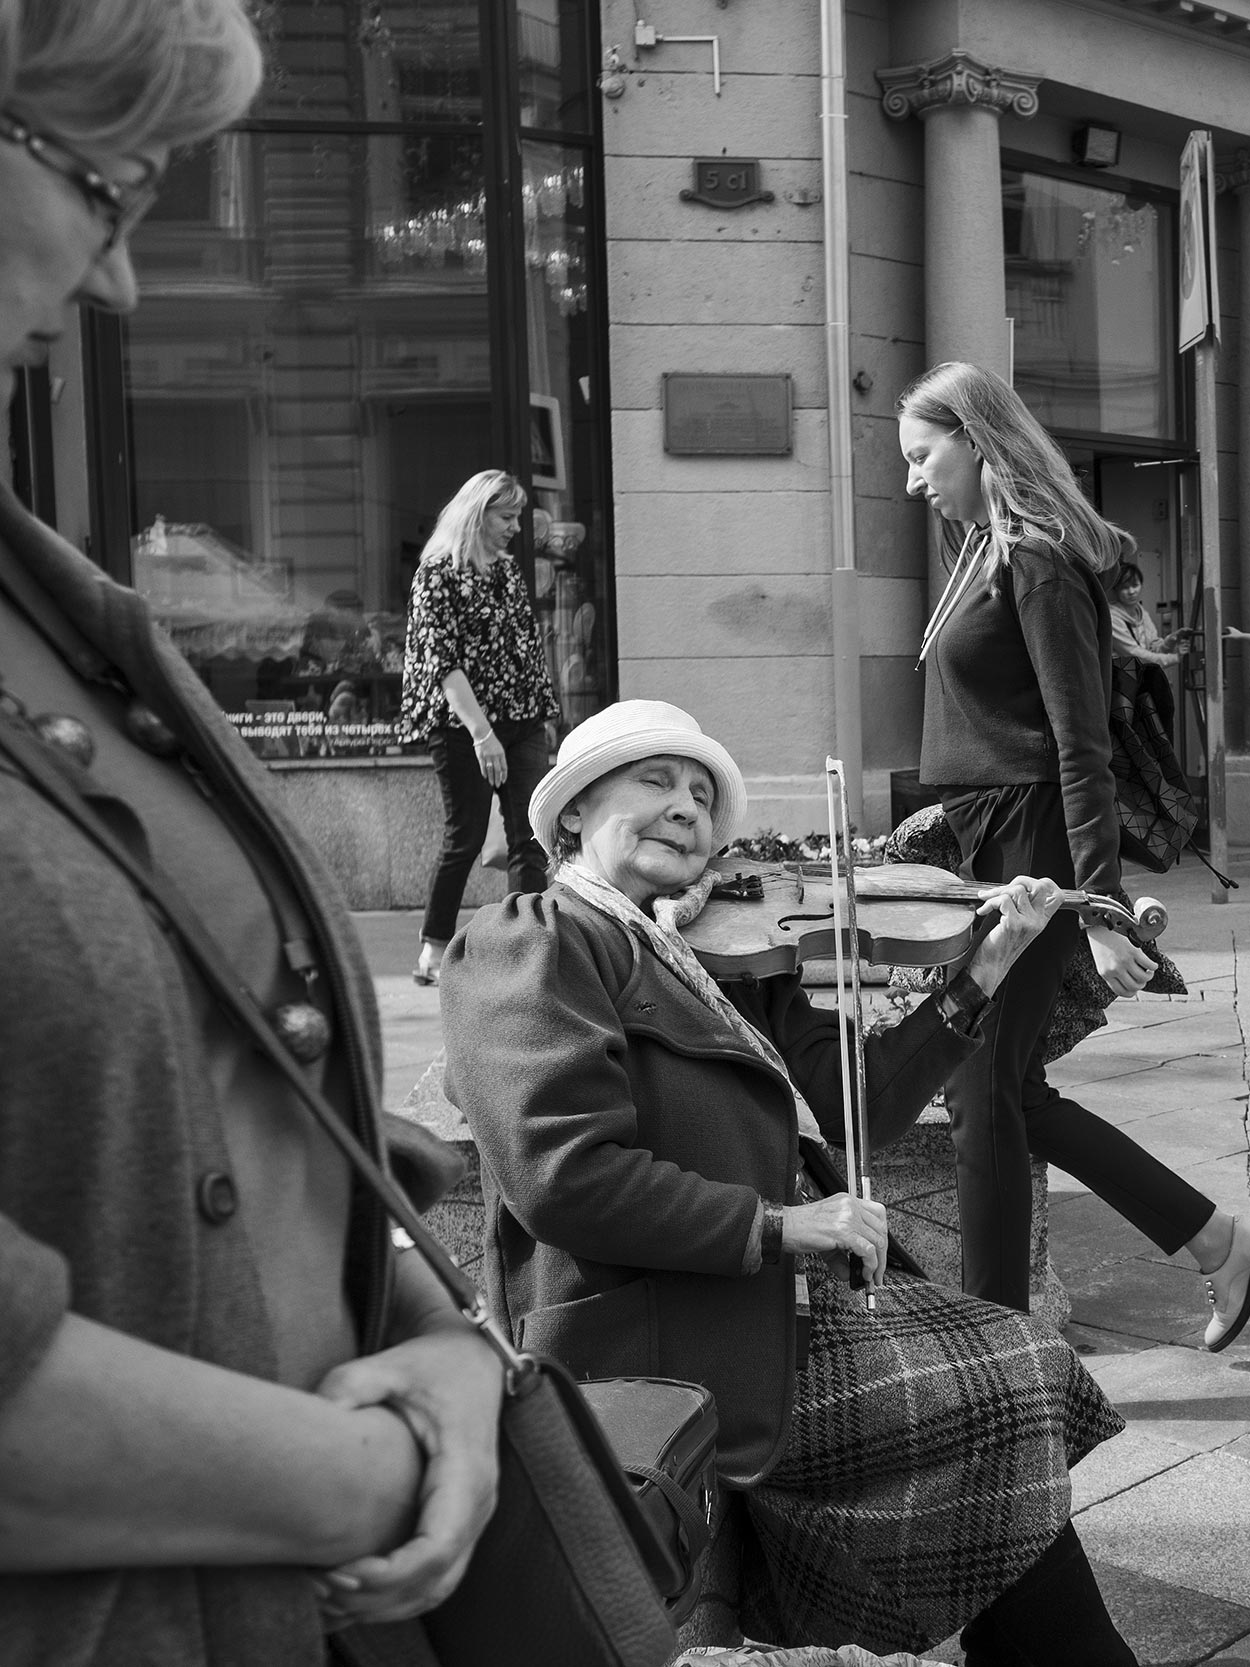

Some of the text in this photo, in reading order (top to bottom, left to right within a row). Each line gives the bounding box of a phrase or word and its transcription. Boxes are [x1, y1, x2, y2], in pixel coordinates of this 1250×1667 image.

[704, 171, 719, 189] 5
[222, 711, 254, 724] ниги
[264, 711, 286, 724] это
[286, 711, 328, 725] двери,
[240, 725, 293, 739] выводят
[294, 723, 323, 737] тебя
[324, 724, 340, 736] из
